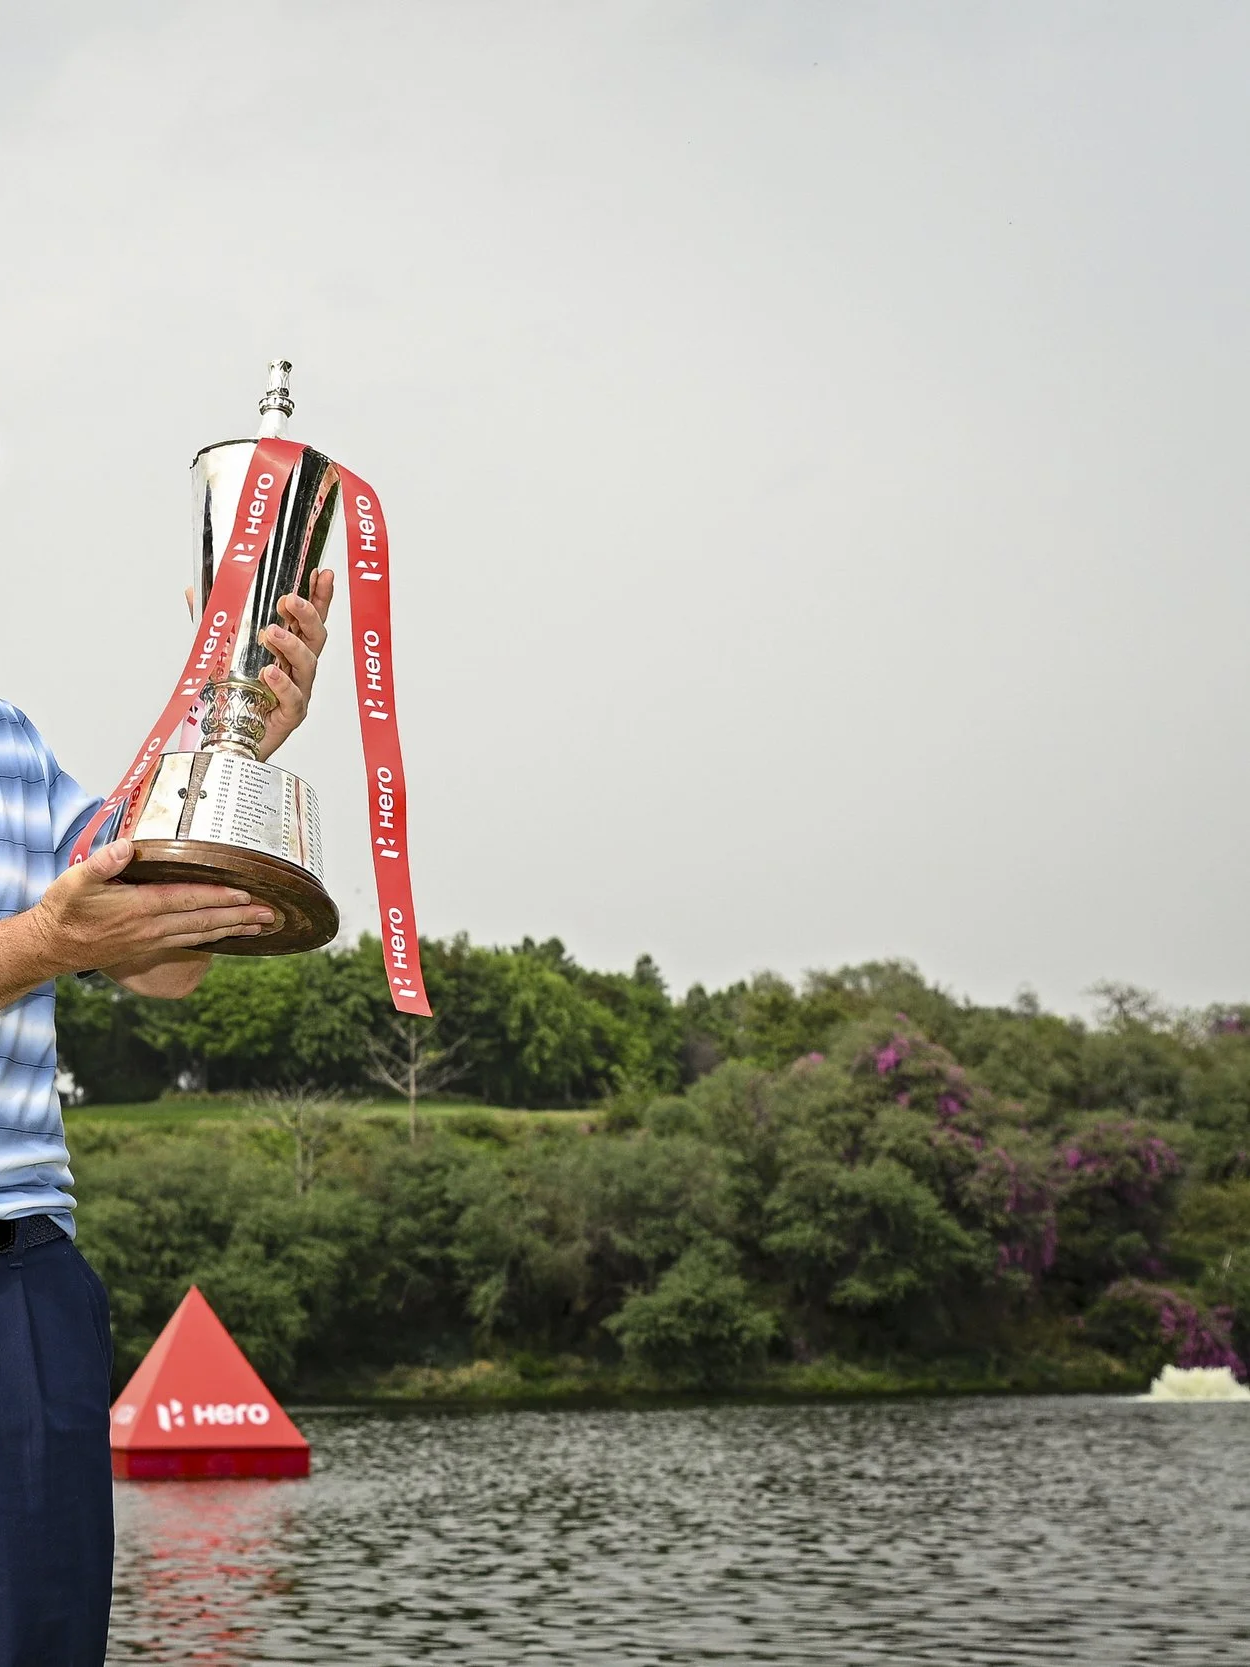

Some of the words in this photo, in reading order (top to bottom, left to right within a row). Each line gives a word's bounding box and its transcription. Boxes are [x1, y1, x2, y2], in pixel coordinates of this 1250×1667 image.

[245, 472, 275, 535] Hero
[356, 495, 378, 552] Hero
[195, 610, 228, 669] Hero
[363, 629, 383, 691] Hero
[123, 737, 161, 790] Hero
[377, 766, 394, 829] Hero
[388, 907, 408, 970] Hero
[192, 1402, 270, 1426] Hero
